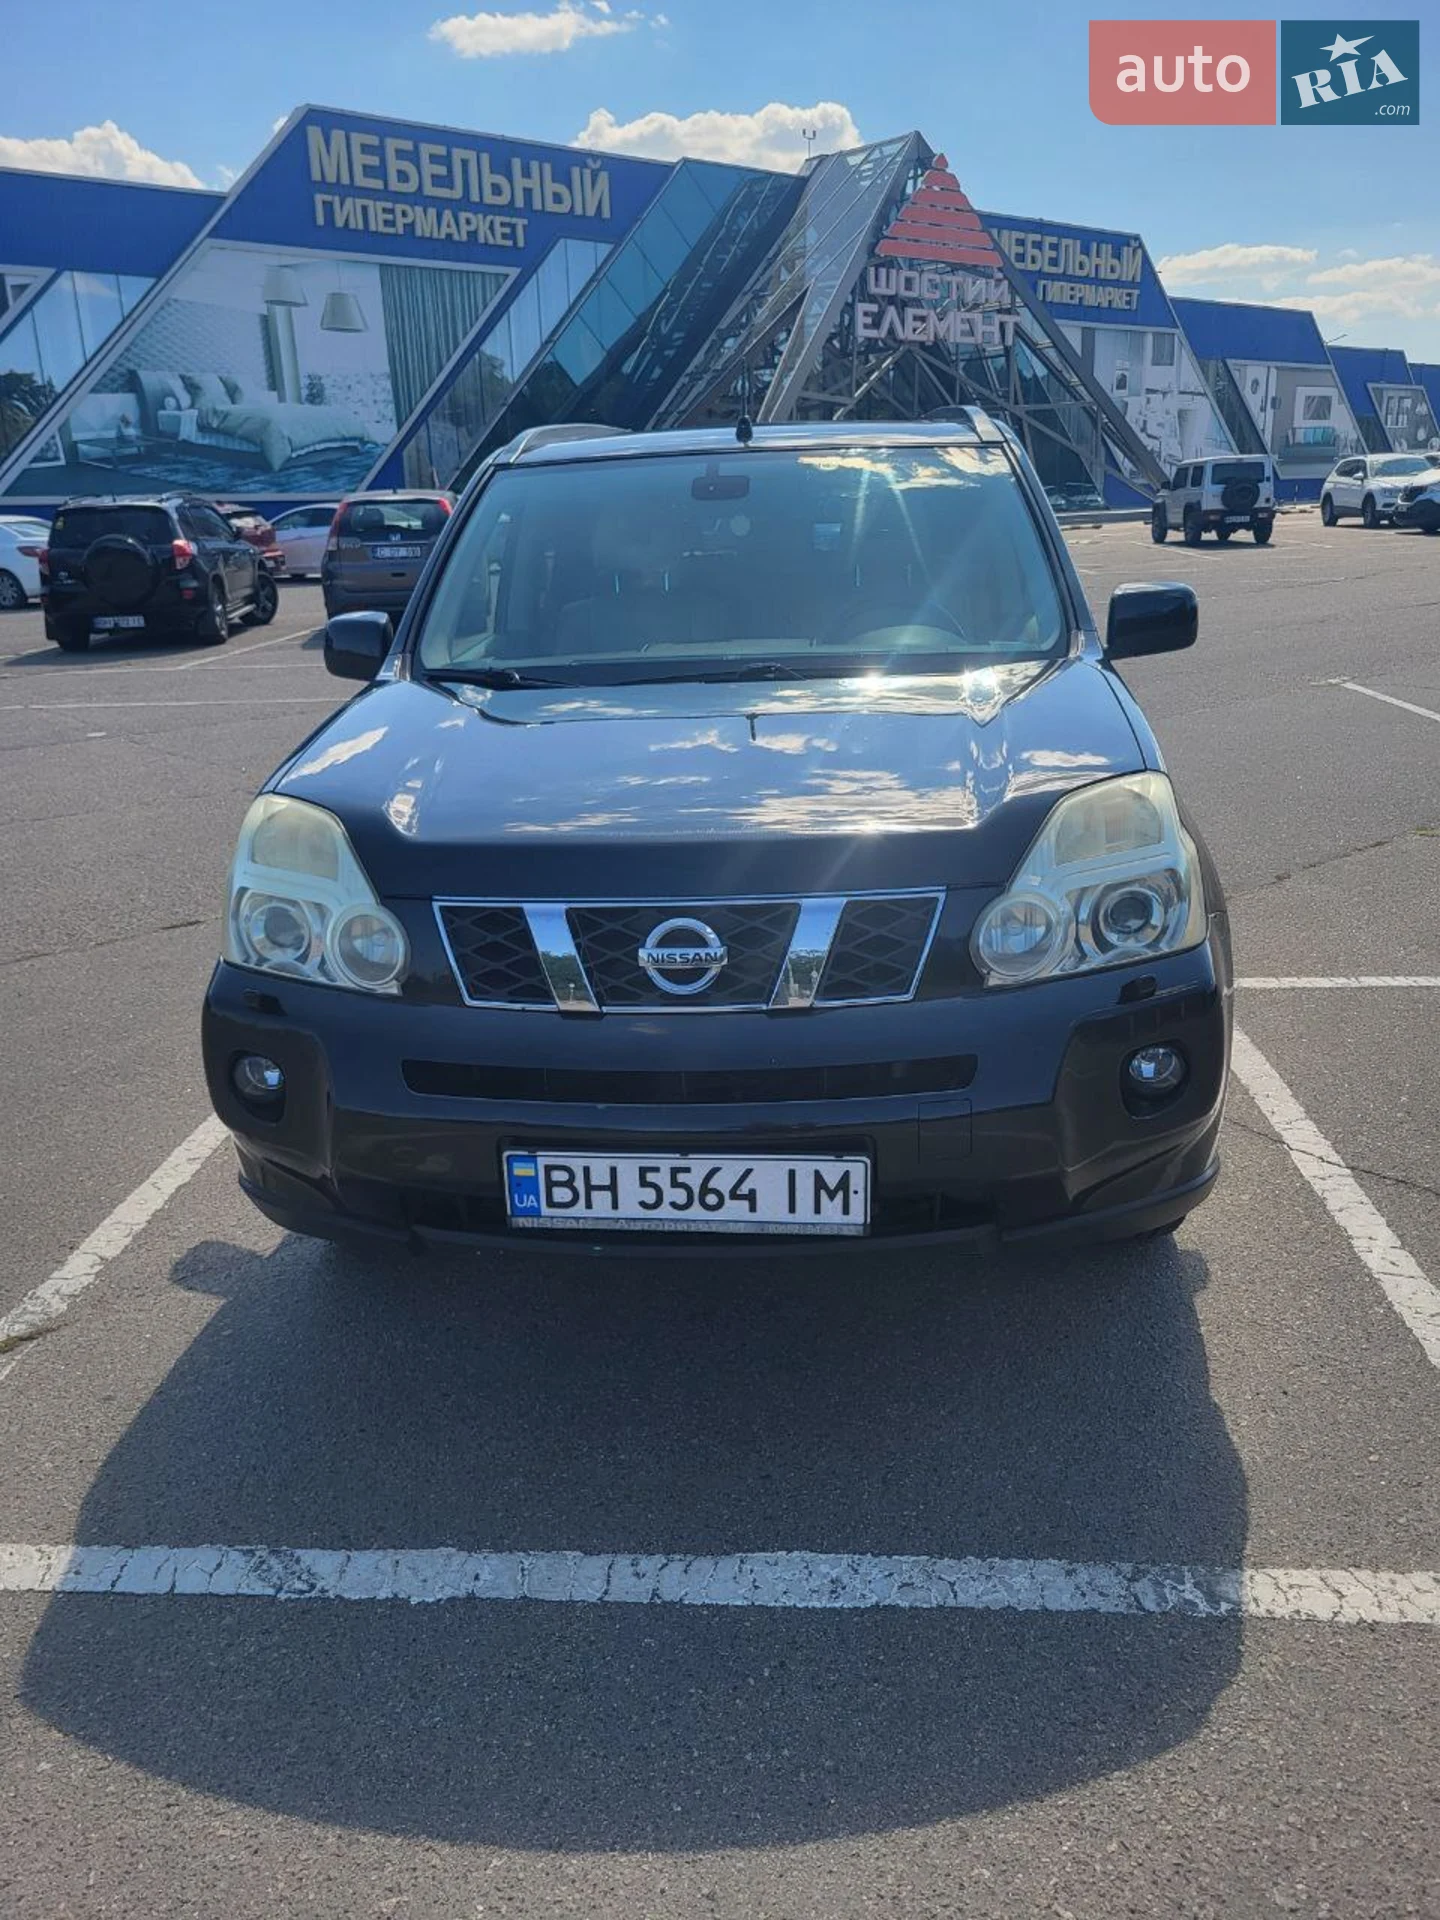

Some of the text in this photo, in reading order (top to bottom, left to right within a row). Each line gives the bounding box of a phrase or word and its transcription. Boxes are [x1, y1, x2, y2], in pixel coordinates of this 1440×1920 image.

[306, 124, 611, 219] МЕБЕЛЬНЫЙ
[313, 192, 529, 248] ГИПЕРМАРКЕТ
[1037, 279, 1141, 311] ГИПЕРМАРКЕТ
[856, 301, 1021, 346] ЕЛЕМЕНТ
[646, 951, 718, 964] NISSAN
[513, 1192, 539, 1209] UA
[543, 1163, 620, 1211] BH
[637, 1165, 758, 1213] 5564
[517, 1216, 589, 1230] NISSAN
